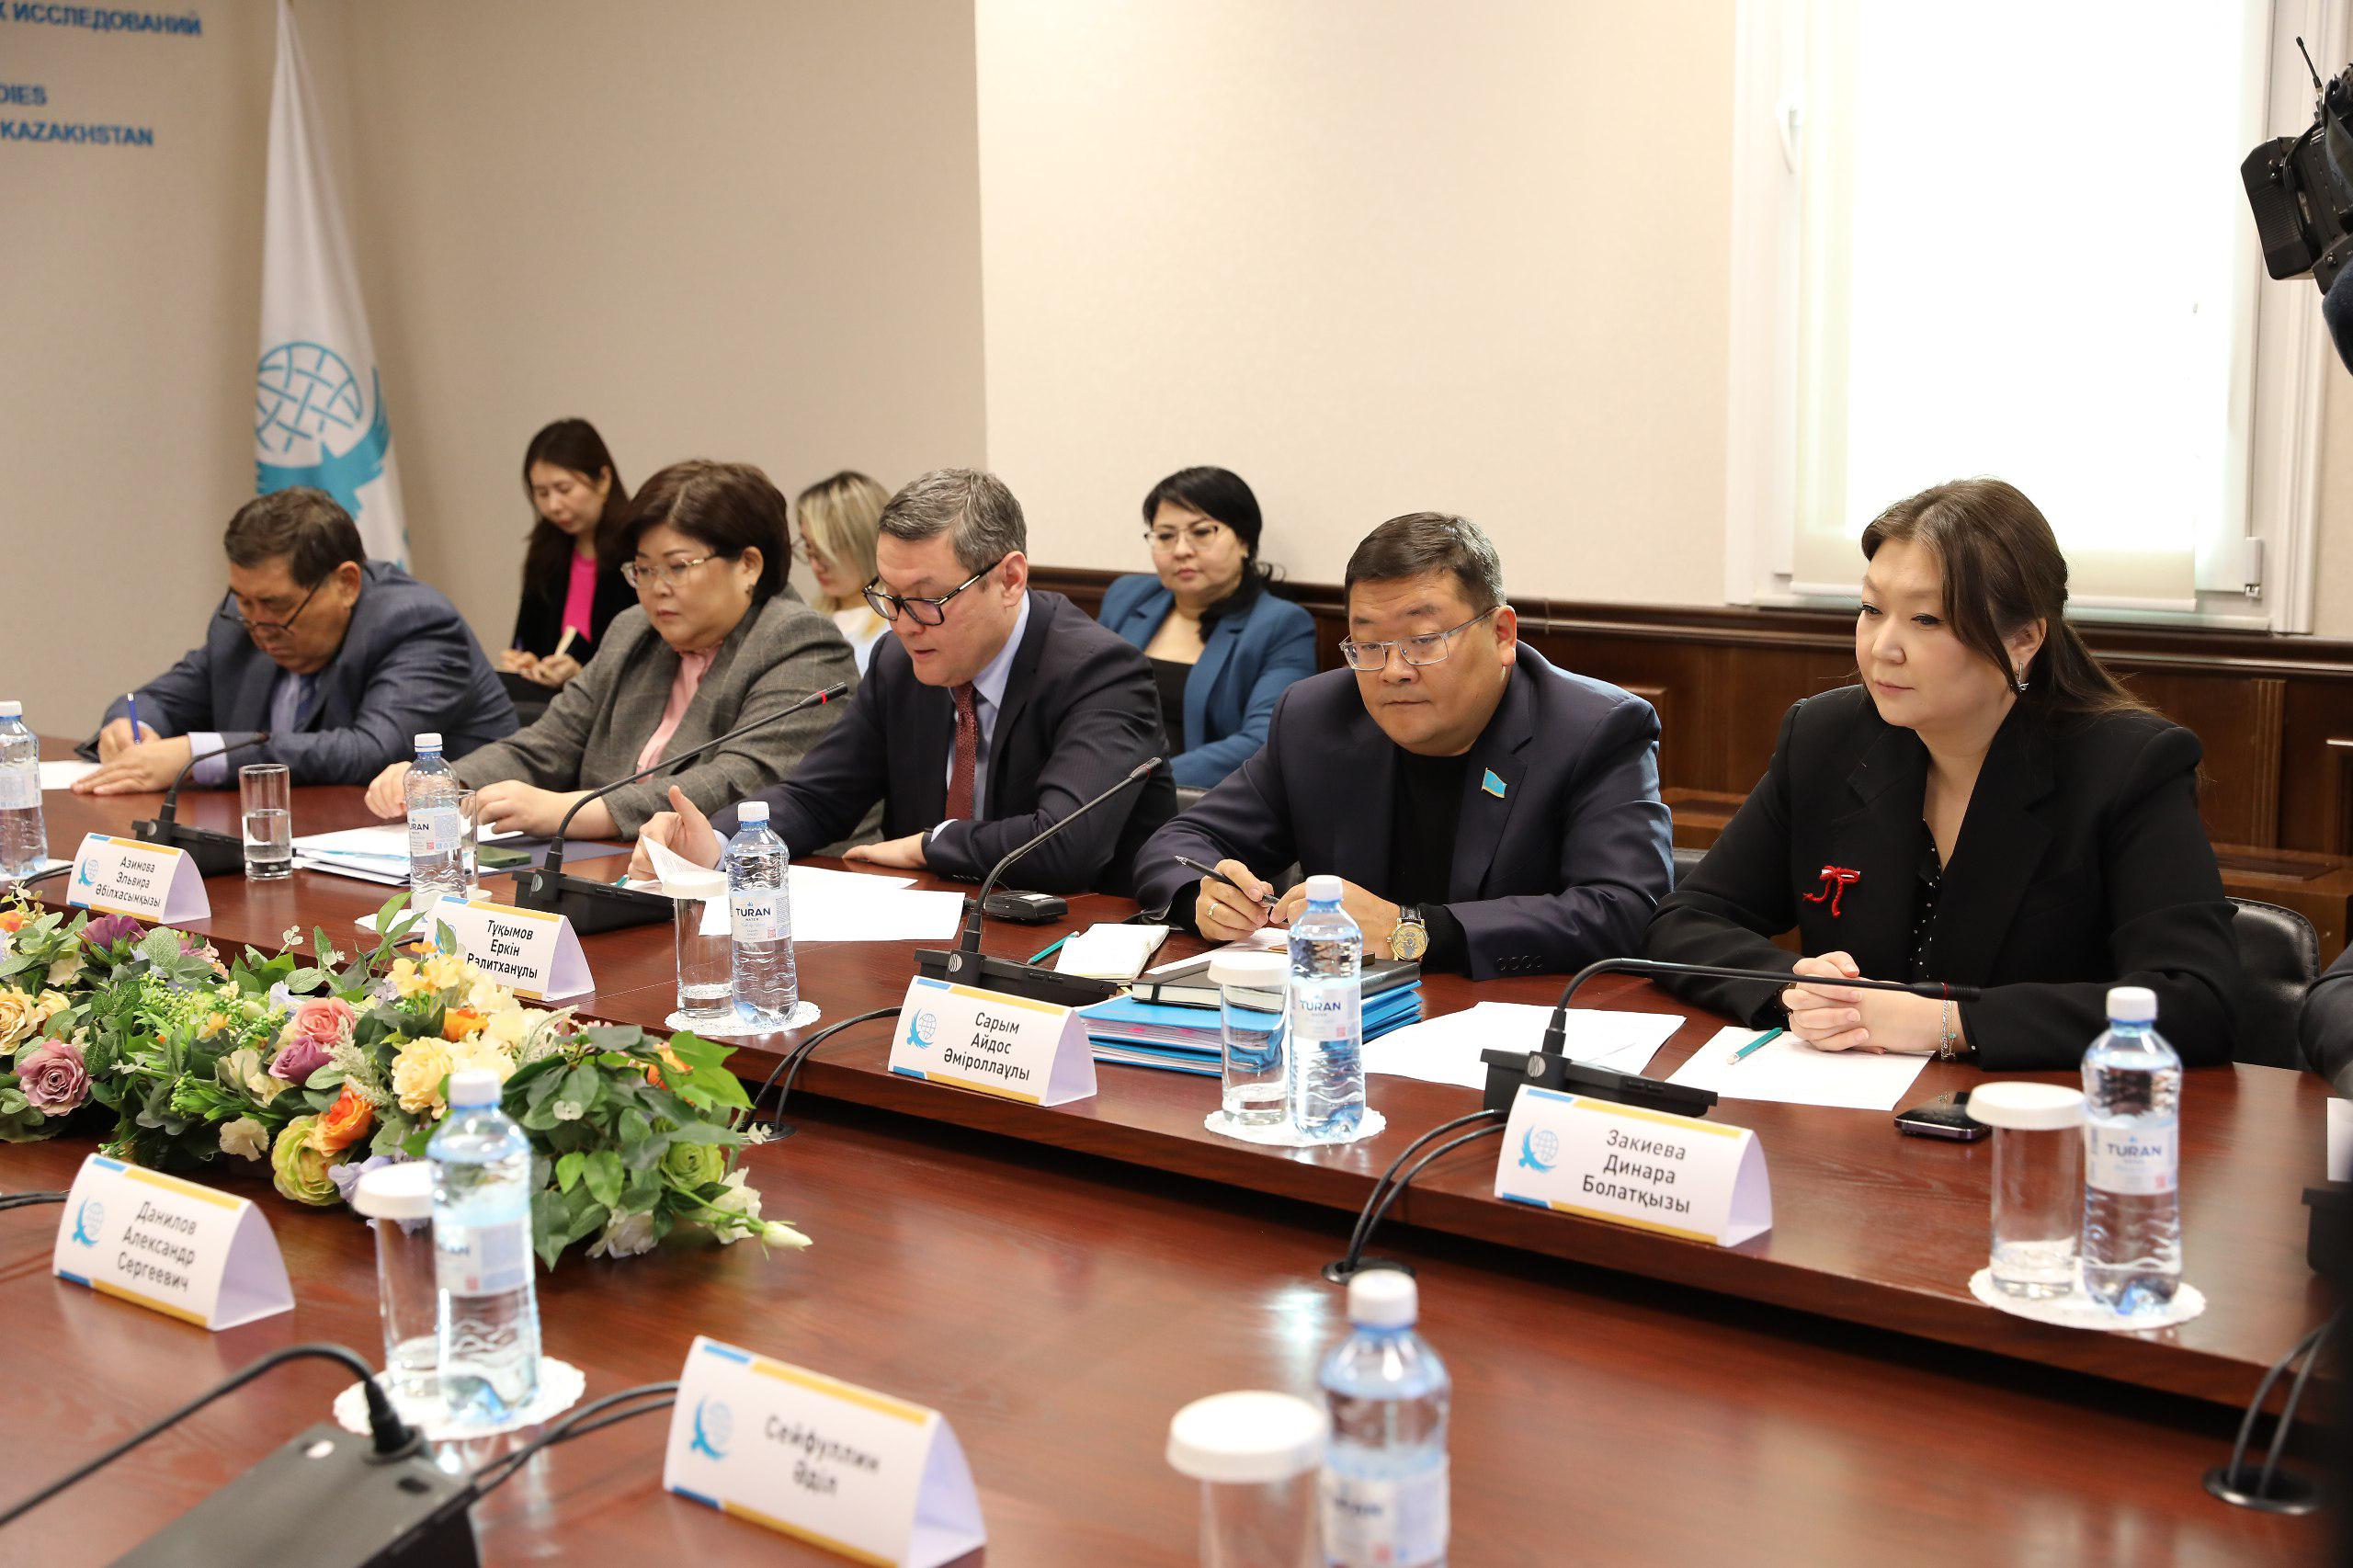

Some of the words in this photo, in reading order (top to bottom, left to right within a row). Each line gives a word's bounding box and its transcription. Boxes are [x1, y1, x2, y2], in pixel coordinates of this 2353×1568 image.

[1, 120, 154, 146] KAZAKHSTAN
[119, 857, 155, 873] Азимова
[116, 871, 151, 891] Эльвира
[735, 907, 771, 917] TURAN
[487, 919, 534, 940] Тұқымов
[490, 939, 520, 957] Еркін
[1300, 1000, 1341, 1011] TURAN
[974, 1012, 1020, 1035] Сарым
[971, 1032, 1012, 1054] Айдос
[943, 1048, 1030, 1081] Әміроллаұлы
[1606, 1129, 1687, 1161] Закиева
[2107, 1143, 2162, 1156] TURAN
[1603, 1154, 1677, 1185] Динара
[1582, 1175, 1690, 1214] Болатқызы
[135, 1200, 198, 1235] Данилов
[122, 1225, 196, 1267] Александр
[118, 1251, 190, 1293] Сергеевич
